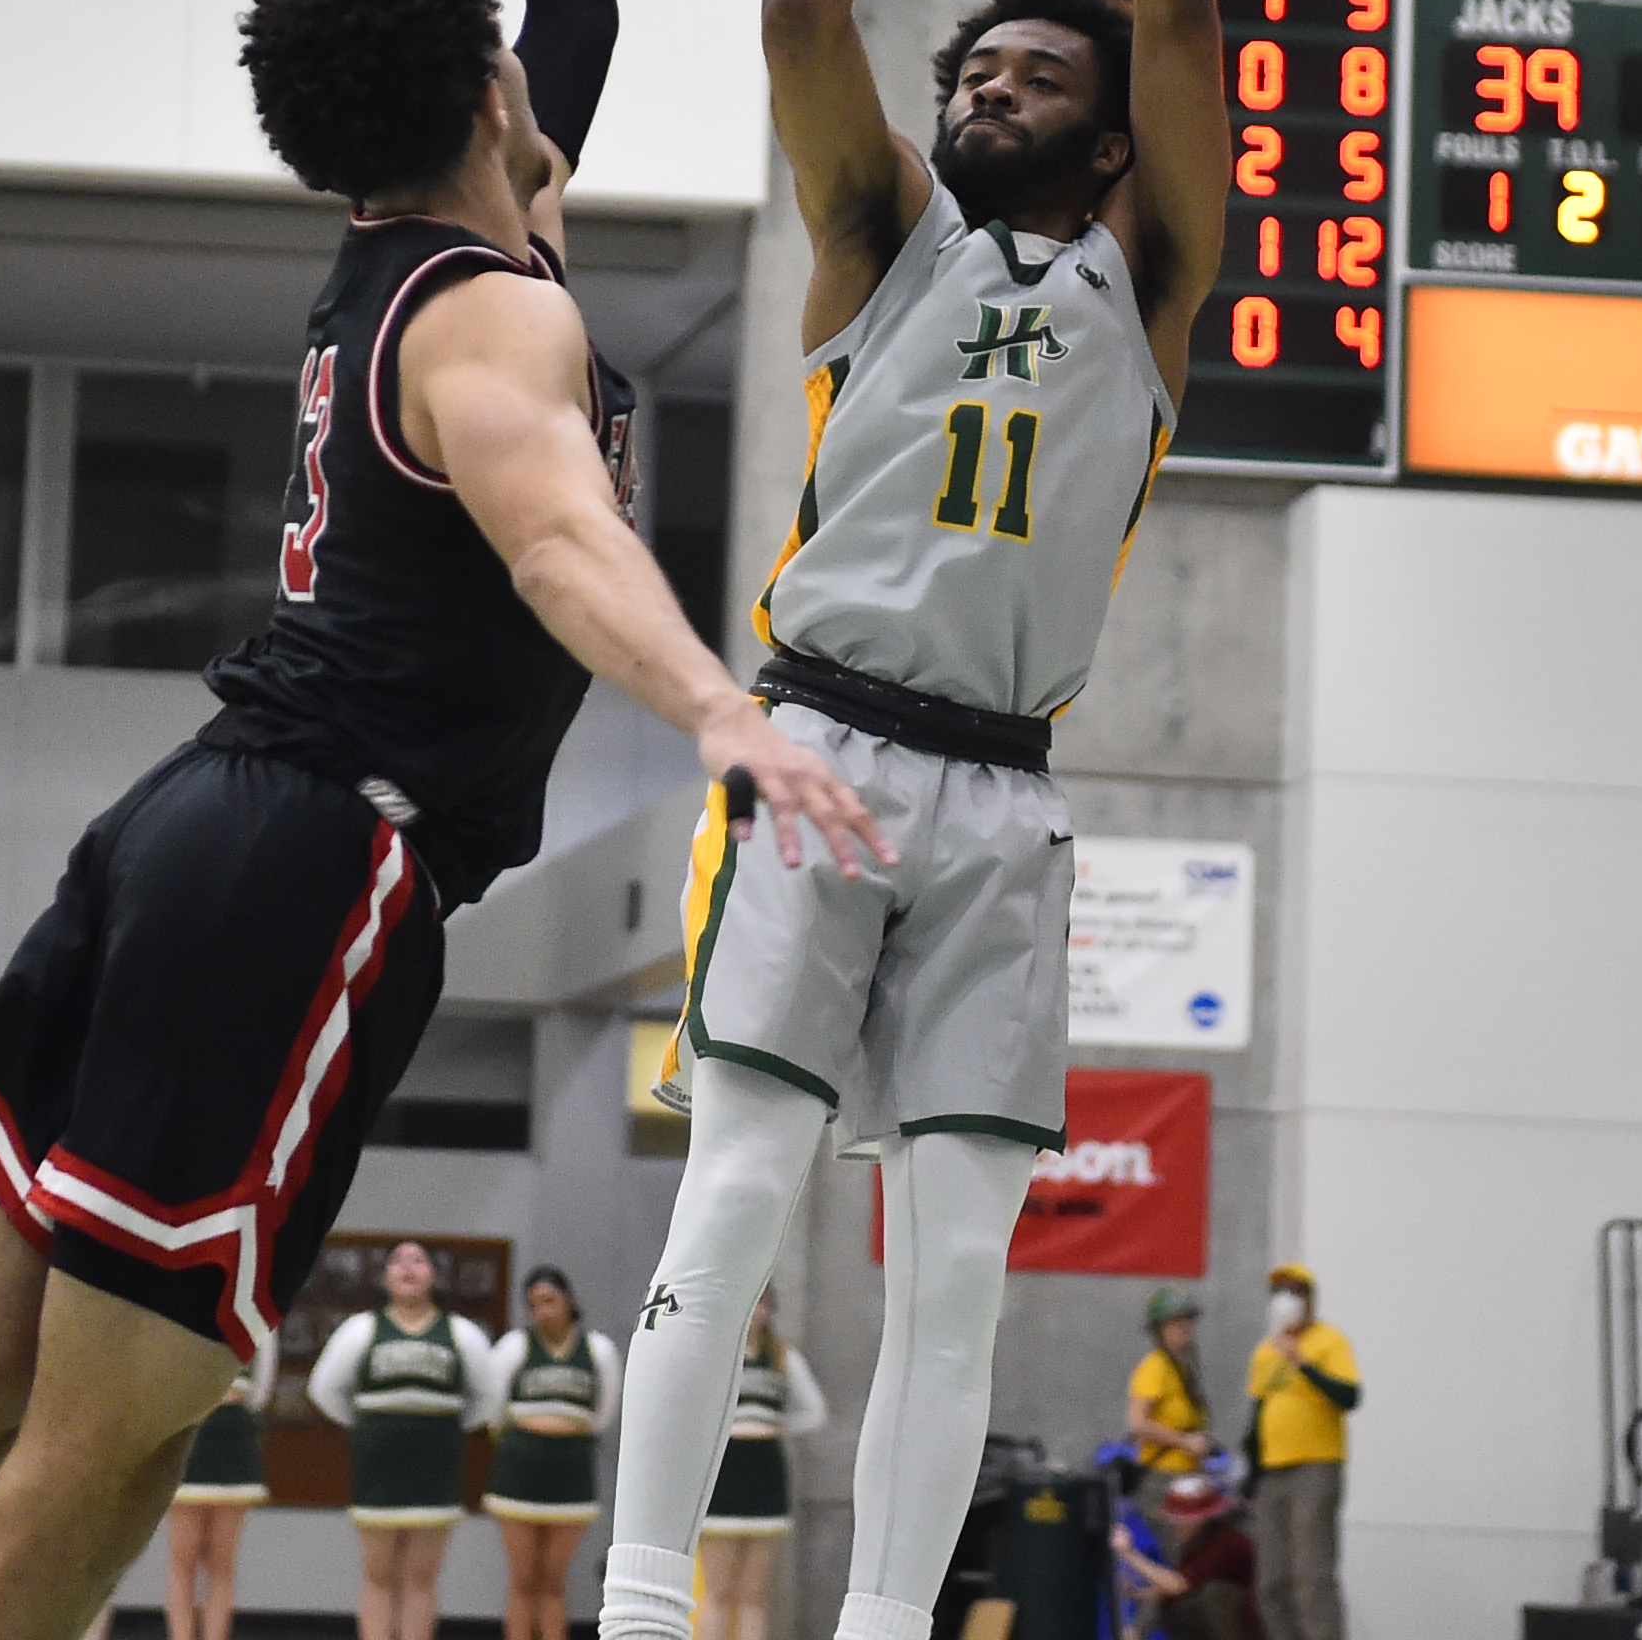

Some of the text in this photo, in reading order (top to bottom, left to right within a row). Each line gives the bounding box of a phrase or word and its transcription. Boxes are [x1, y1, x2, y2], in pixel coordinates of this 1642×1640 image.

[1237, 40, 1387, 117] 0 8
[1474, 45, 1580, 133] 39
[1235, 124, 1385, 203] 2 5
[1436, 131, 1521, 163] FOULS
[1488, 170, 1511, 233] 1
[1557, 170, 1606, 244] 2
[1259, 216, 1384, 288] 1 12
[1433, 241, 1517, 273] SCORE
[1231, 296, 1382, 369] 0 4
[278, 345, 340, 603] 3
[932, 400, 1042, 544] 11
